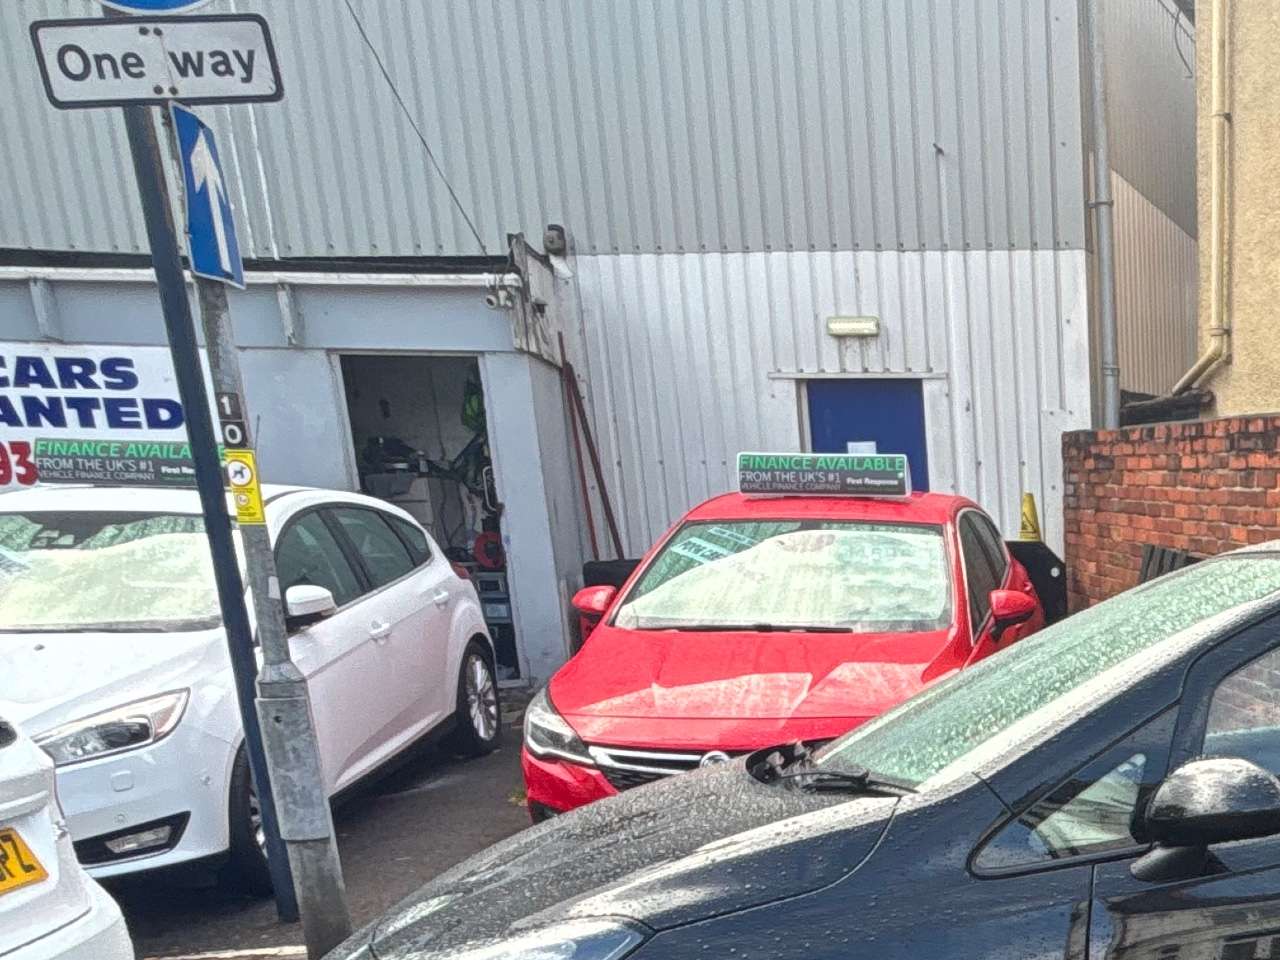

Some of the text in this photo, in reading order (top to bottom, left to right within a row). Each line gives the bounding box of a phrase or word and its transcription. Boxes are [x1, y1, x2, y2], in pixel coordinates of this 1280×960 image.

[57, 44, 255, 83] One way
[0, 355, 139, 391] ARS
[36, 440, 122, 457] FINANCE
[125, 443, 226, 460] AVAILAE
[36, 457, 73, 470] FROM
[78, 458, 103, 471] THE
[106, 459, 136, 472] UK'S
[740, 455, 905, 471] FINANCE AVAILABLE
[740, 471, 771, 482] FROM
[774, 471, 798, 482] THE
[800, 471, 826, 483] UK'S
